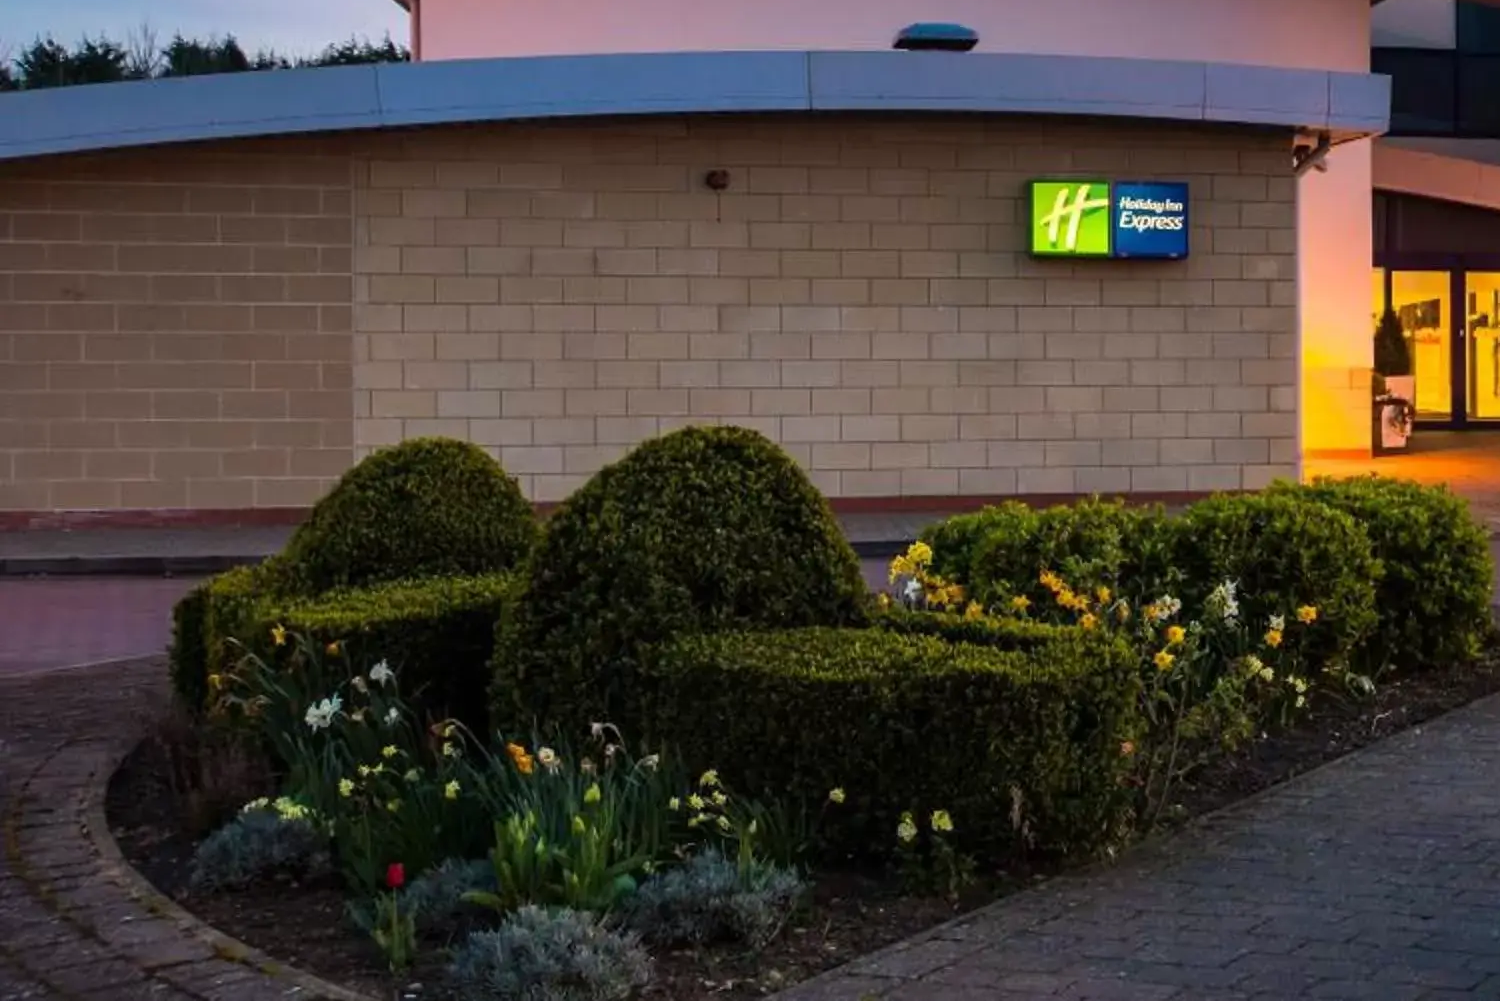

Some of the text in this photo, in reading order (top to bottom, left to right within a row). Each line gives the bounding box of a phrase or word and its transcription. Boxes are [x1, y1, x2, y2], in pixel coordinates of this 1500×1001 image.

[1119, 196, 1164, 213] Holiday
[1039, 184, 1109, 249] H
[1119, 210, 1184, 233] Express
